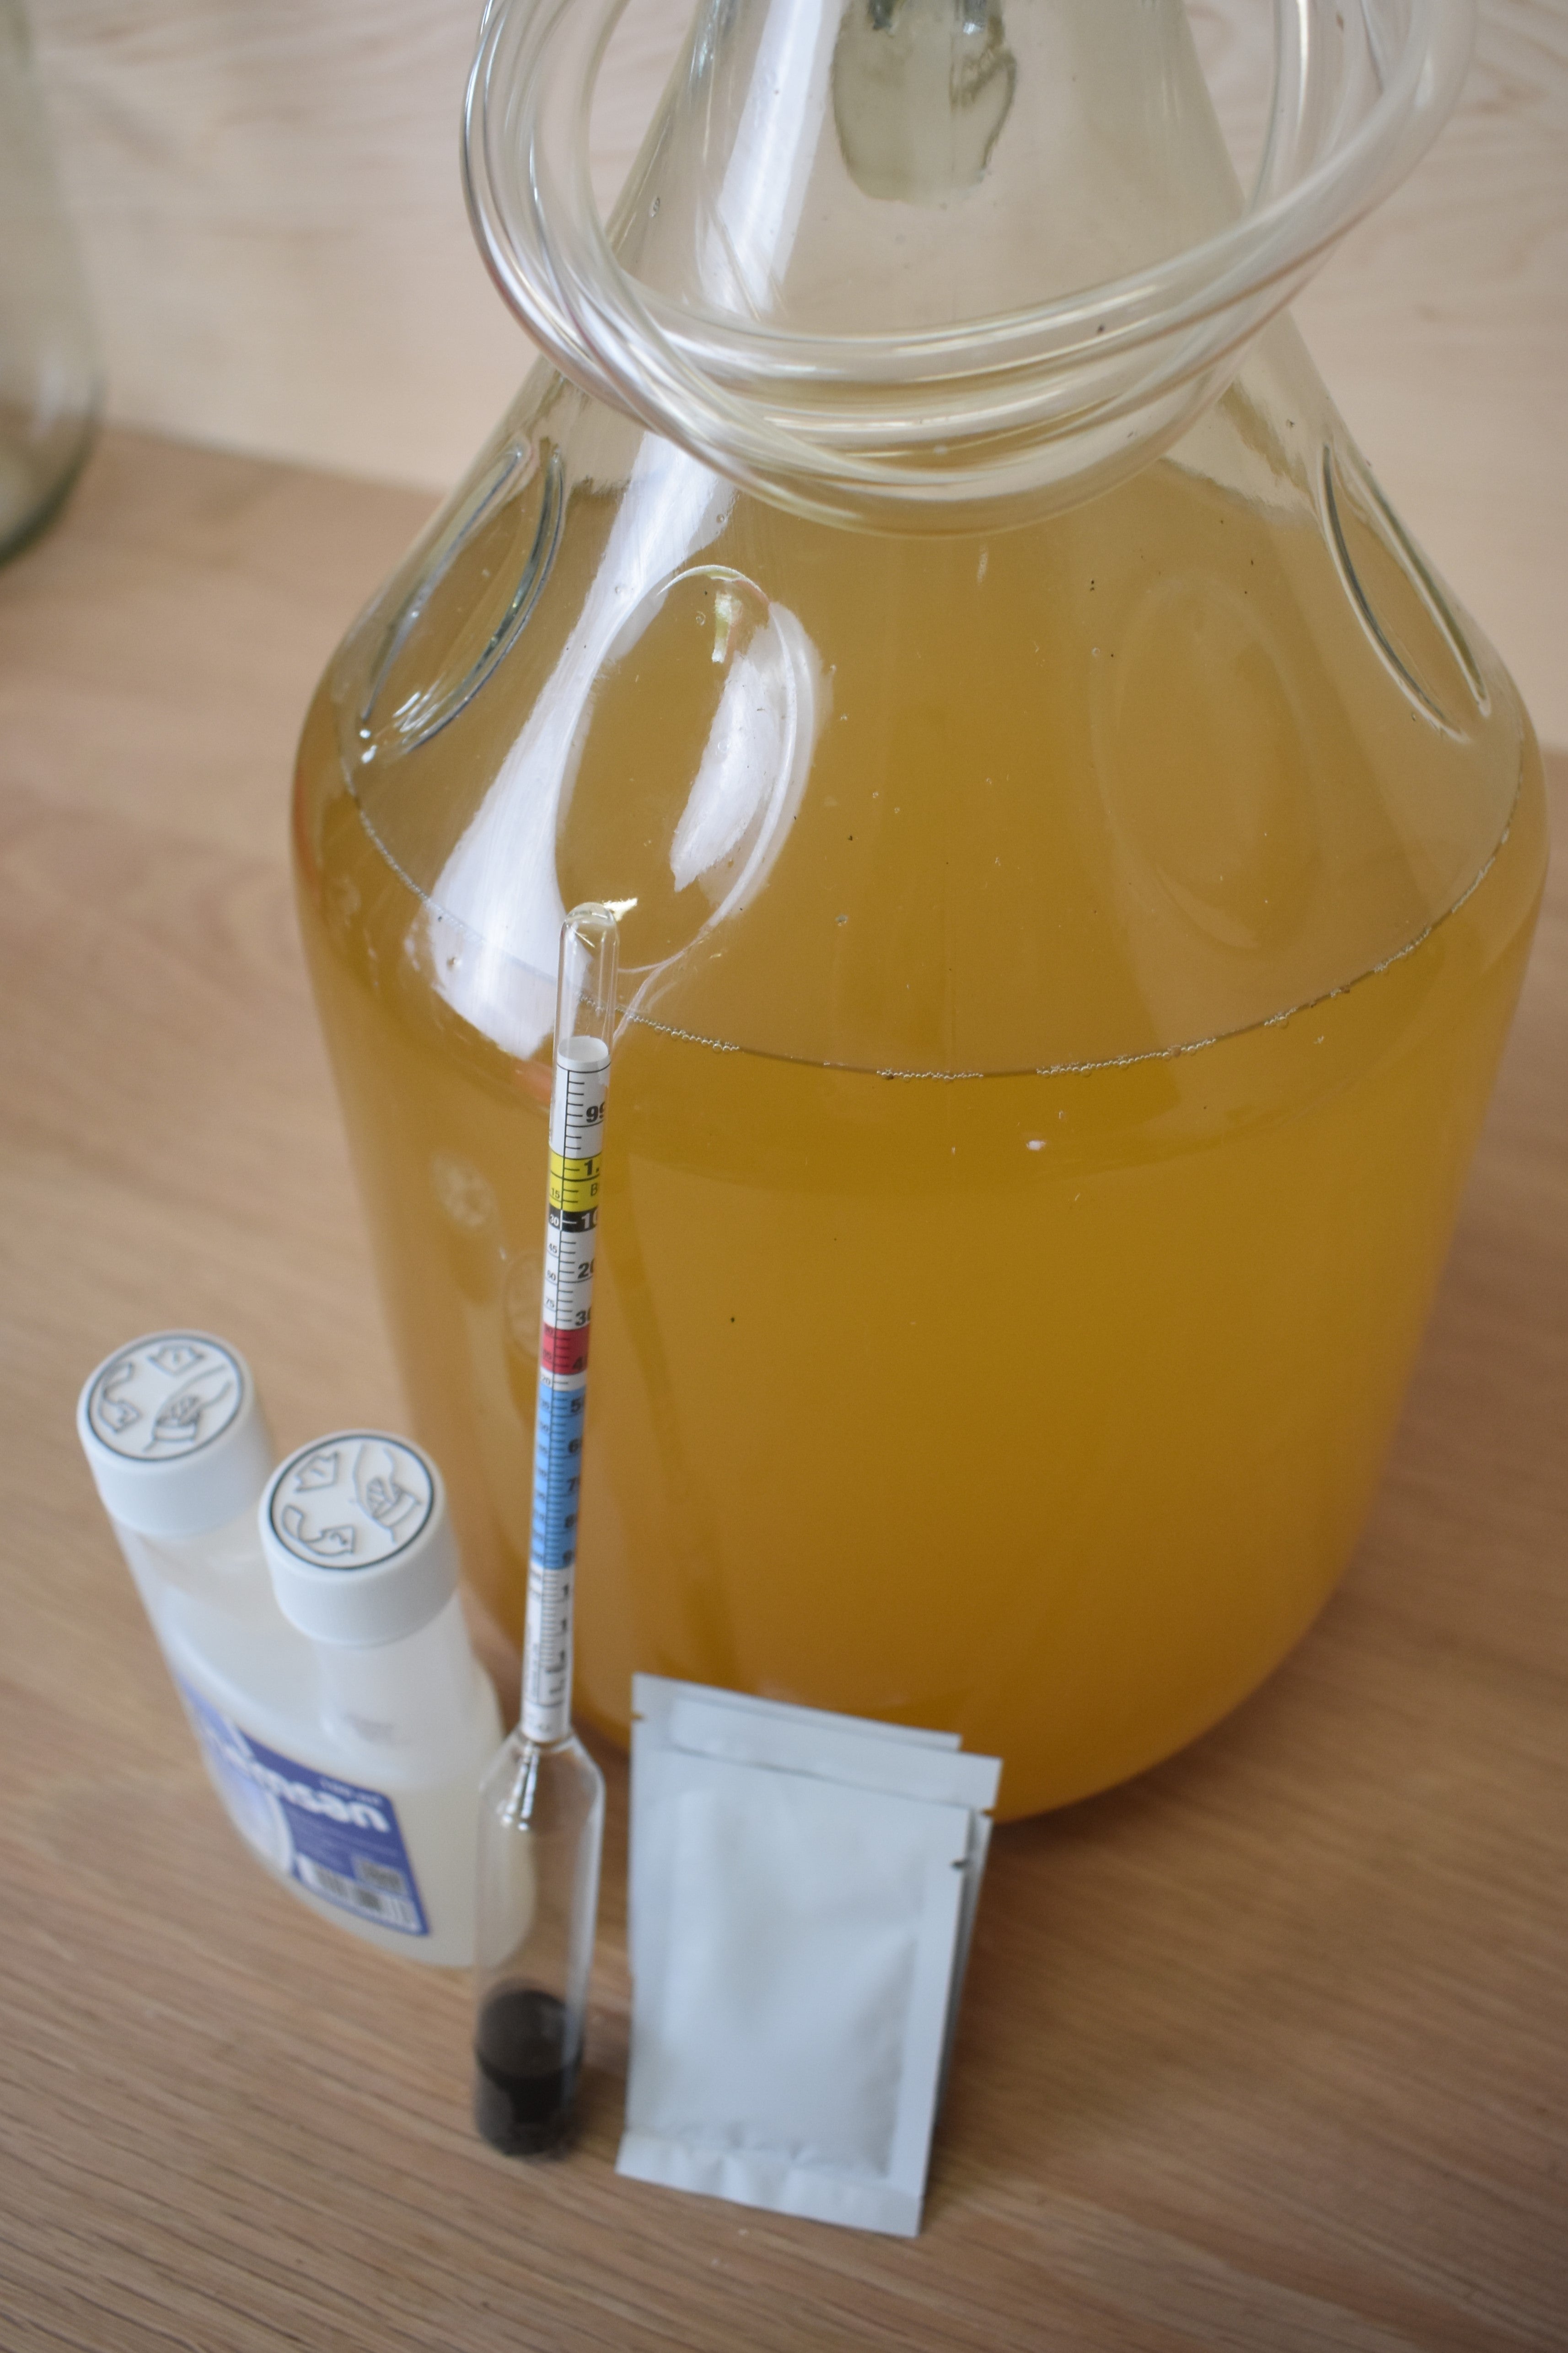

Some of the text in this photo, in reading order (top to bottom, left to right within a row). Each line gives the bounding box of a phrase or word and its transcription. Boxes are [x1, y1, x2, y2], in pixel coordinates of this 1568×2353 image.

[551, 1187, 560, 1199] 15
[549, 1214, 559, 1227] 30
[548, 1243, 557, 1254] 45
